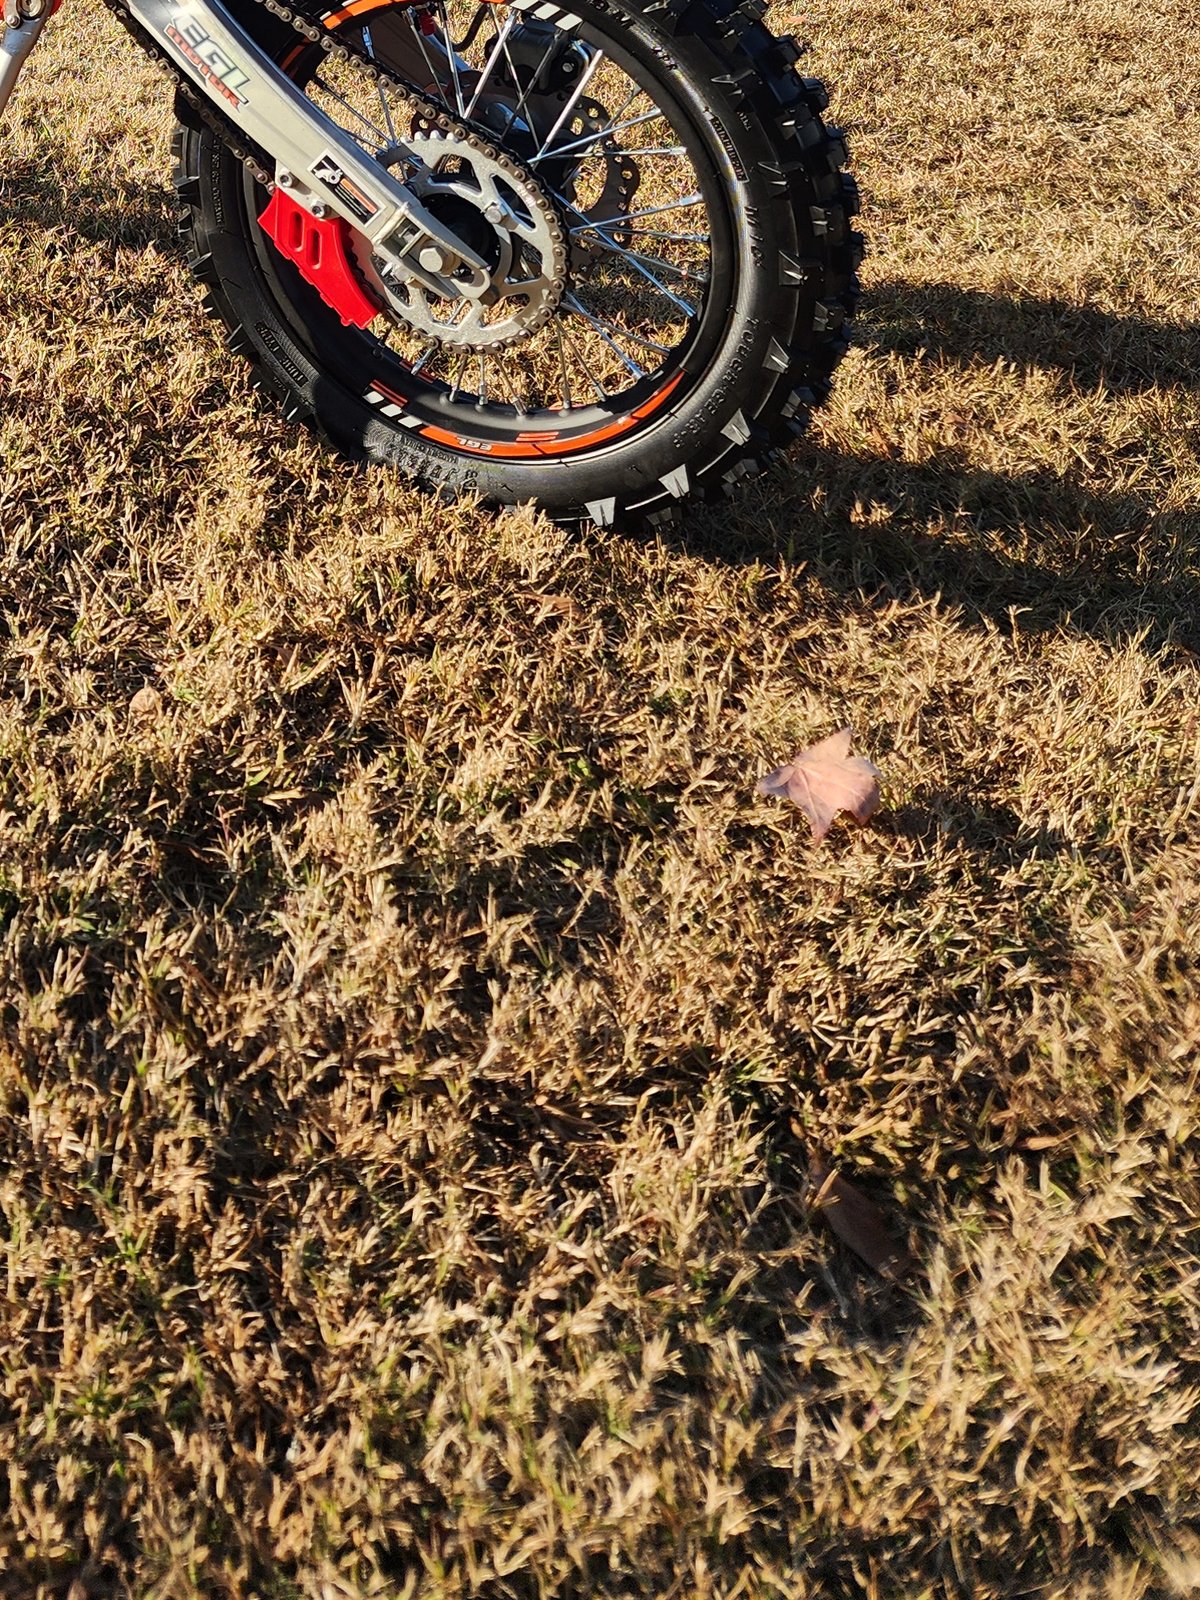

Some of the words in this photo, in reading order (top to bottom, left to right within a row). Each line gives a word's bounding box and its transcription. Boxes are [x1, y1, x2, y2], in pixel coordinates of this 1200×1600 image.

[165, 23, 240, 108] MOTOR
[172, 13, 250, 104] EGL
[456, 436, 492, 451] EGL
